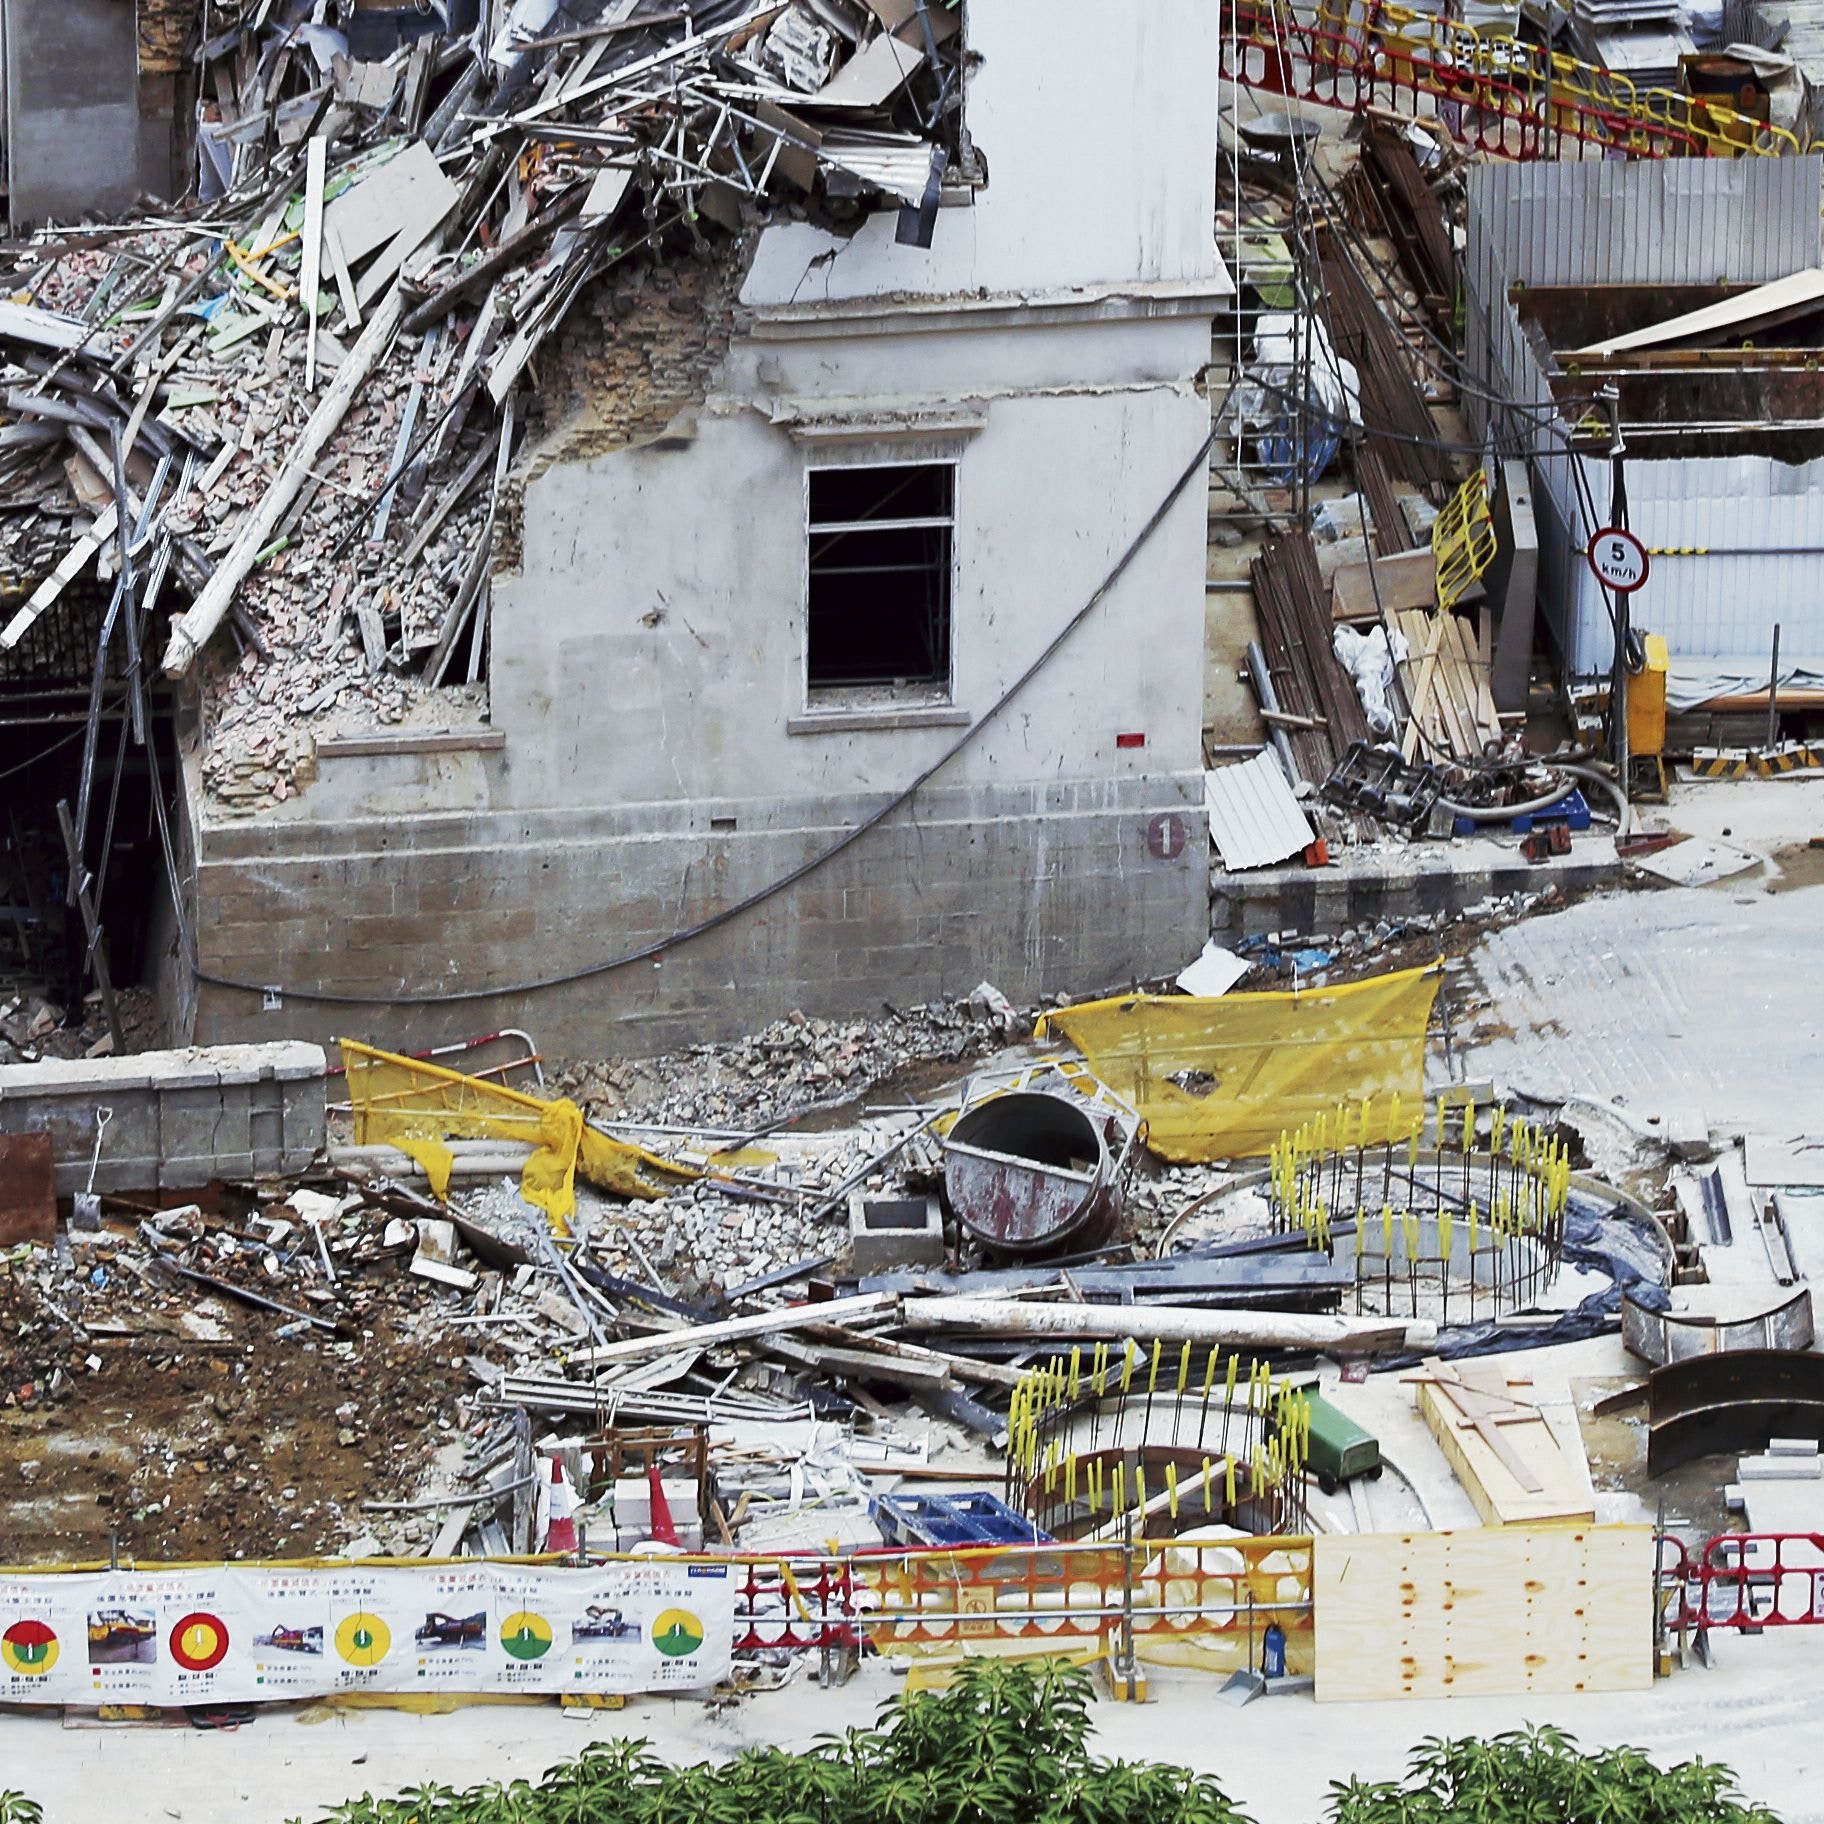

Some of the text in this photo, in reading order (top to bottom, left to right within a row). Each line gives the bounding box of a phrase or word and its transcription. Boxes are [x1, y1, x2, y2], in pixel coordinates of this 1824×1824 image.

[1611, 541, 1625, 562] 5
[1602, 562, 1636, 580] km/h
[1158, 818, 1171, 854] 1
